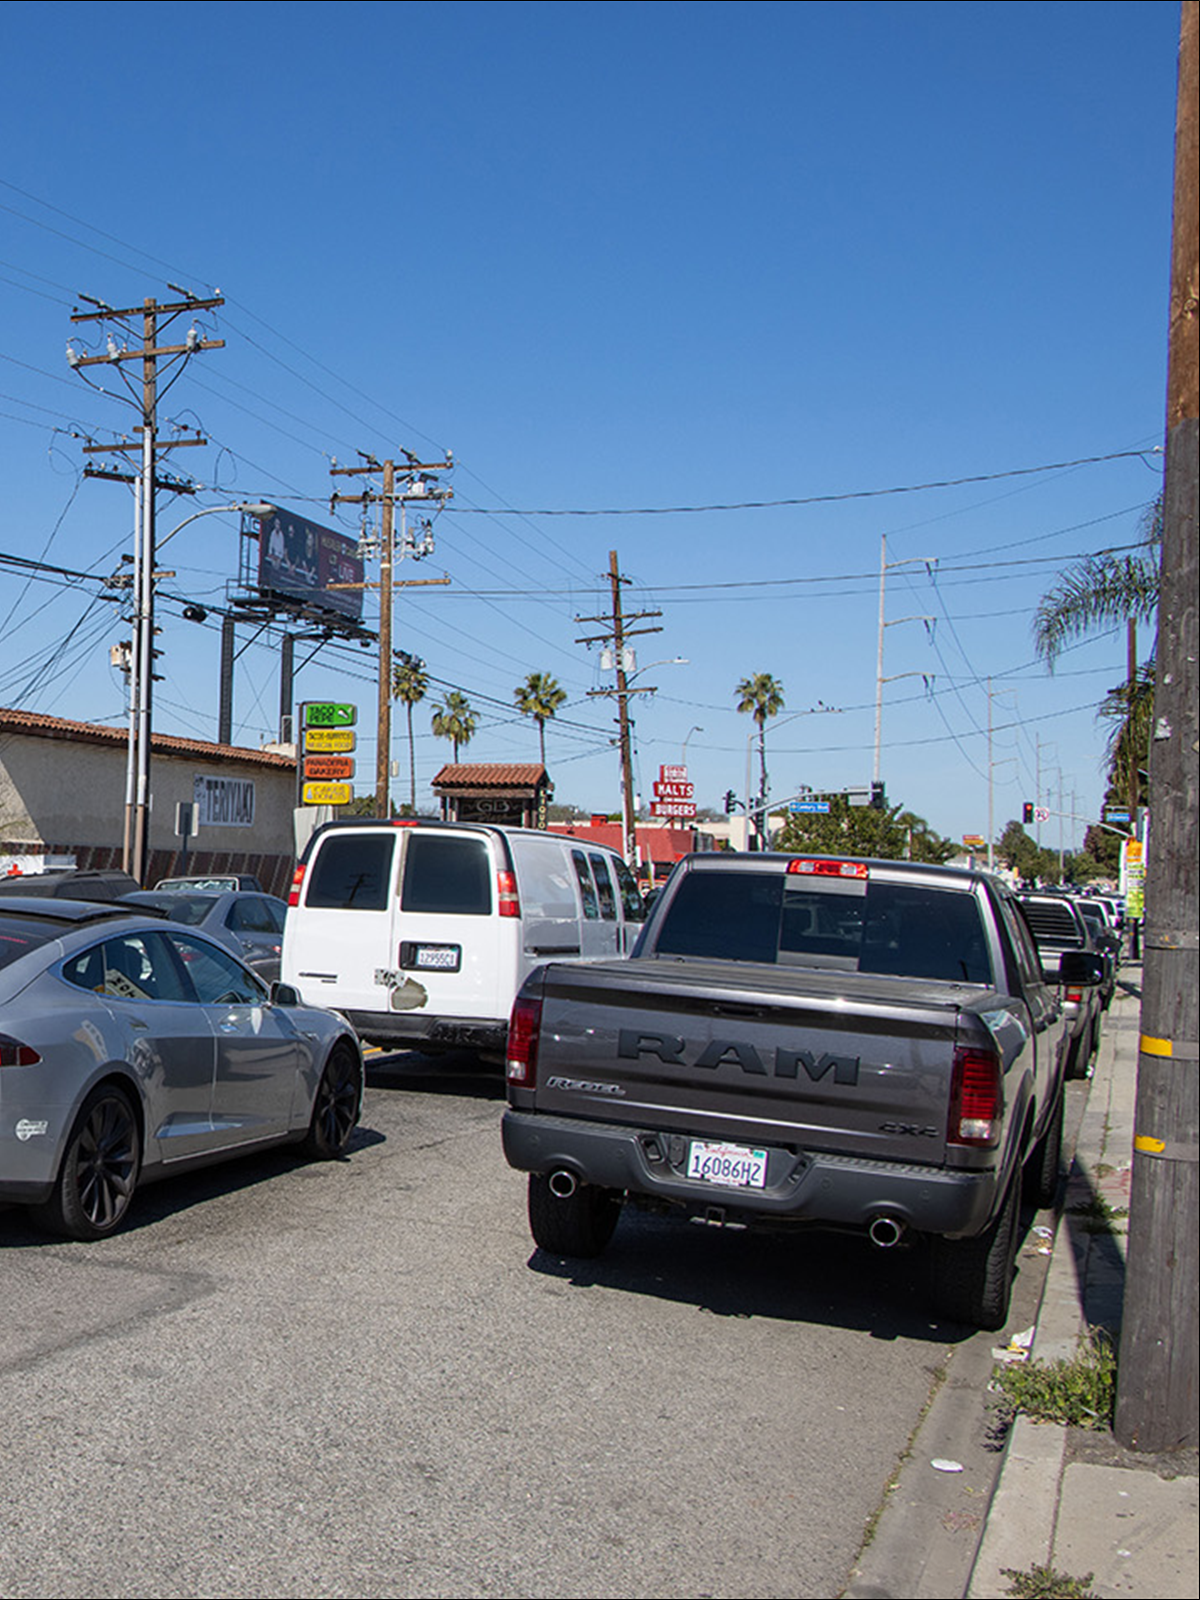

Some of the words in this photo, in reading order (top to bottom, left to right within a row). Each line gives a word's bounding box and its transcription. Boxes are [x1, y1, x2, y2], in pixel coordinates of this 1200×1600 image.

[309, 706, 335, 715] TACO
[309, 714, 334, 722] PEPE
[658, 783, 694, 797] MALTS
[206, 780, 253, 823] TERIYAKI
[655, 804, 696, 816] BURGERS
[617, 1028, 860, 1087] RAM
[691, 1155, 761, 1182] 16086H2
